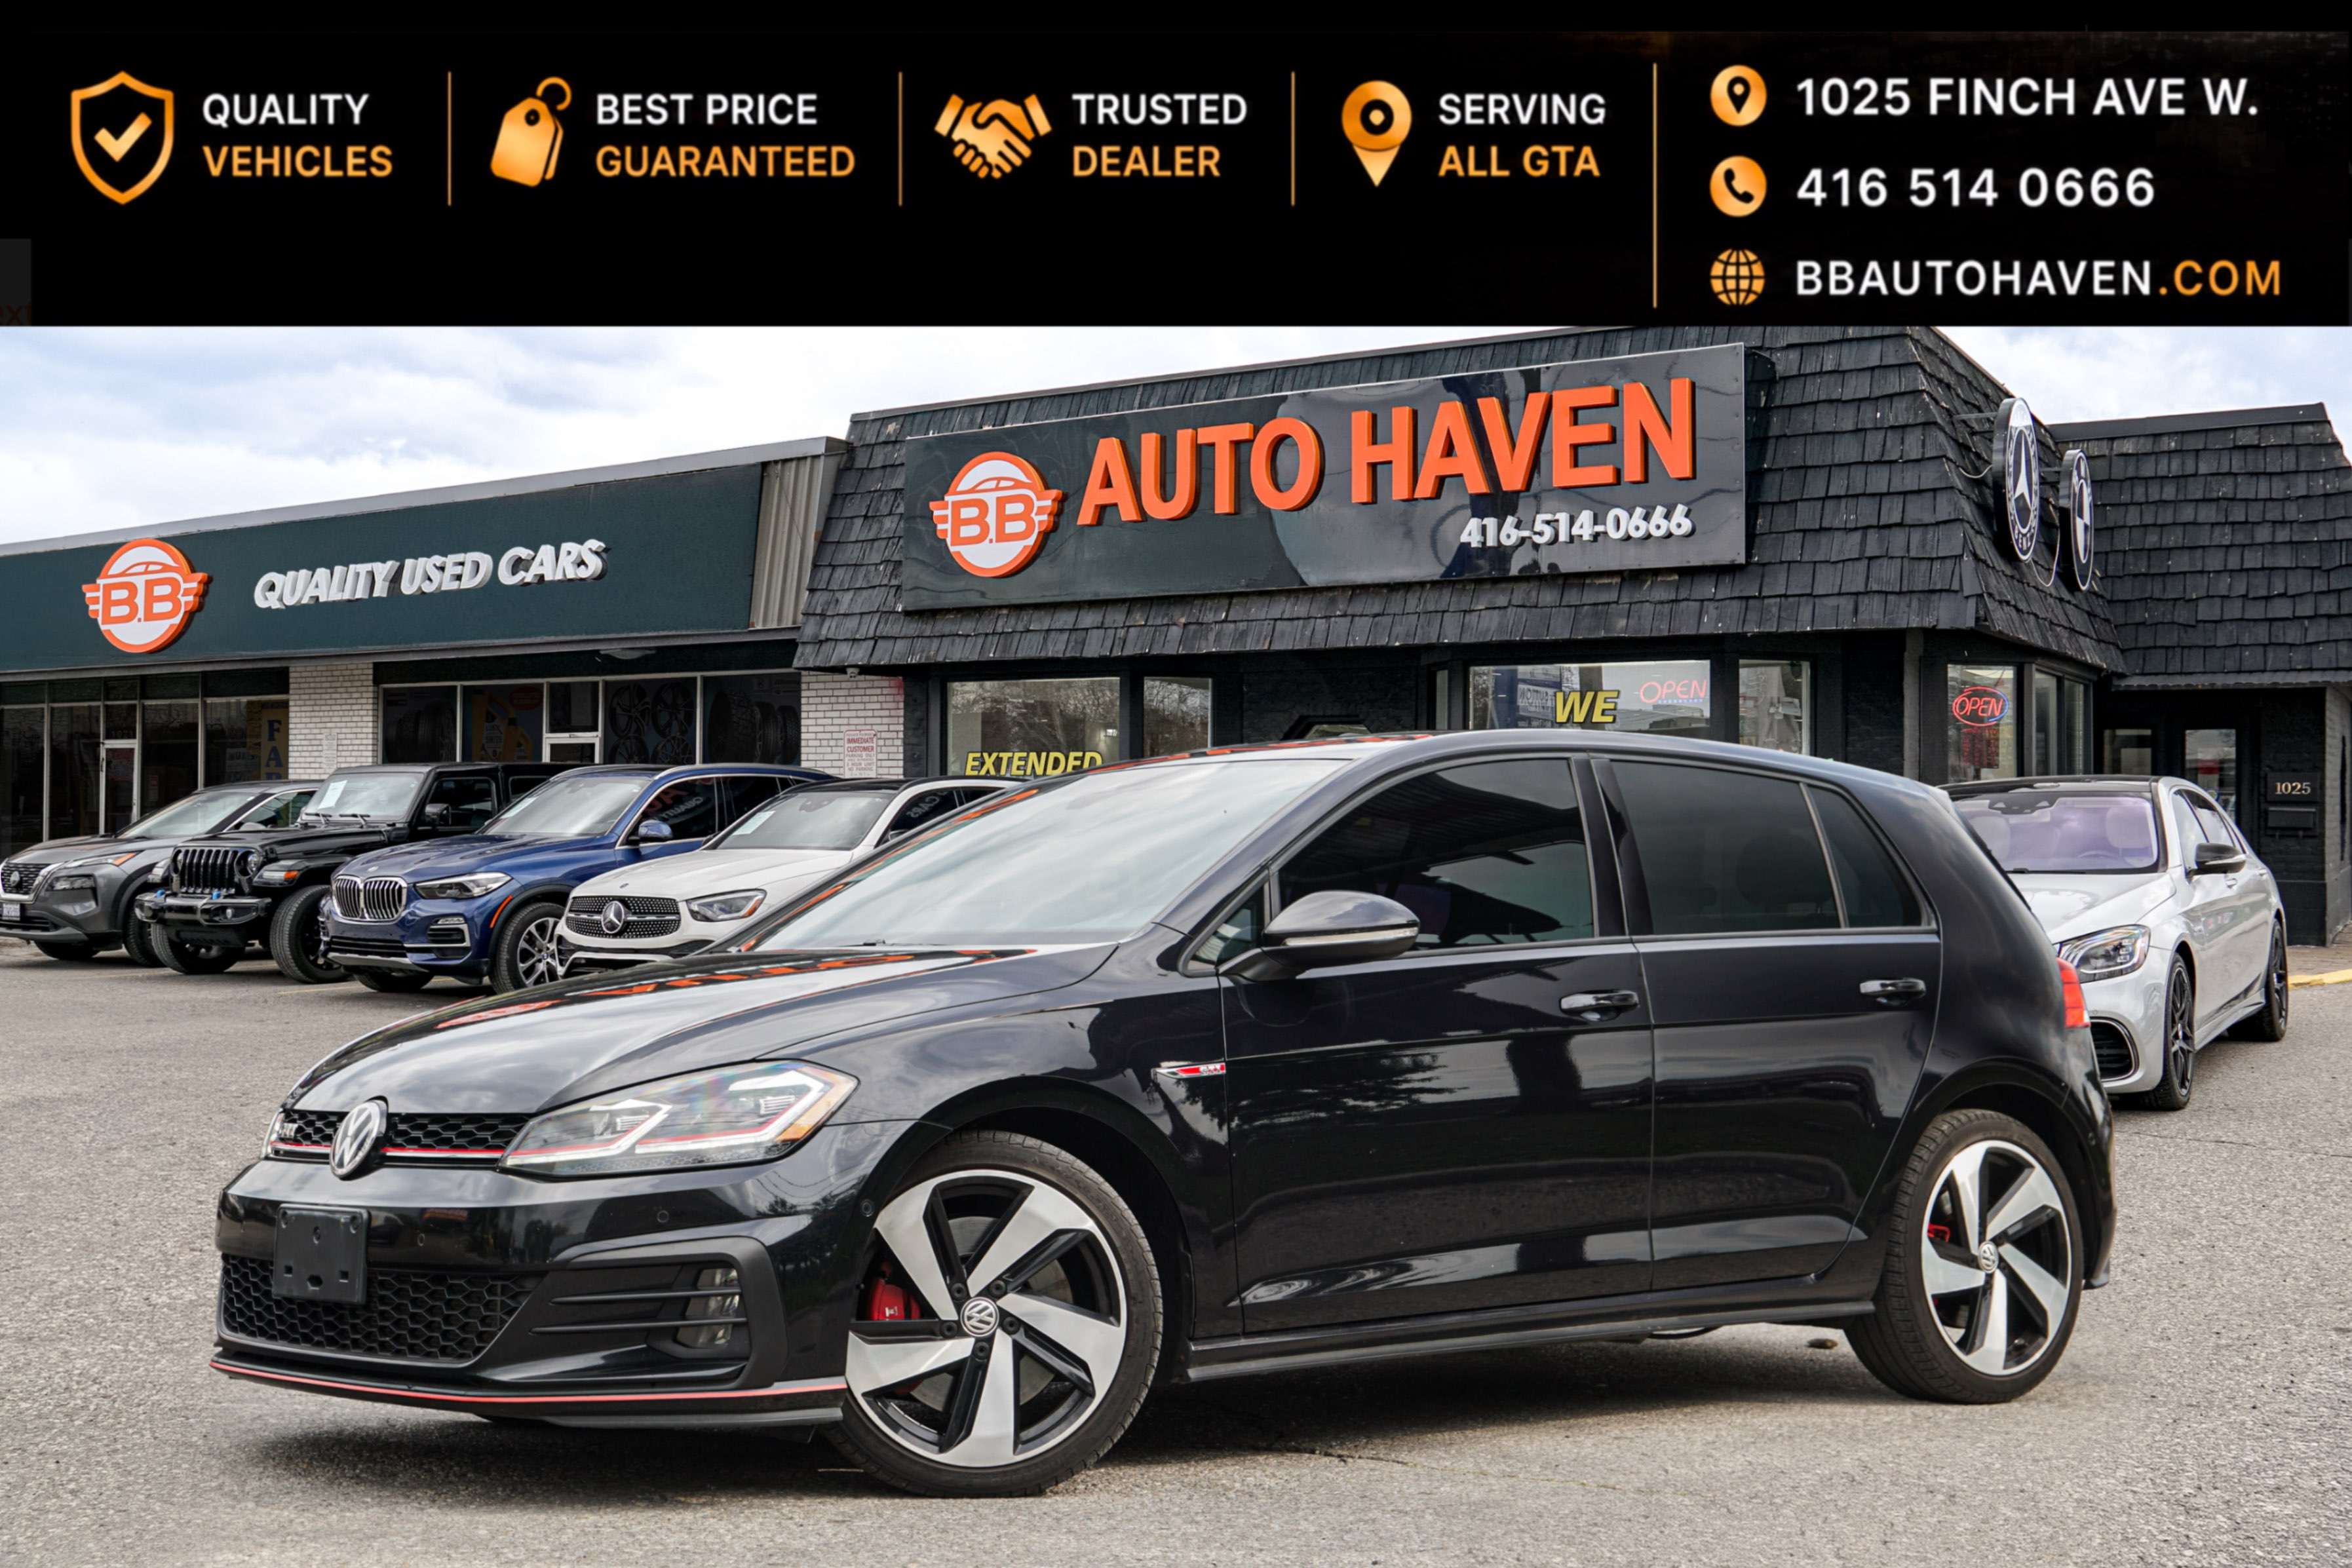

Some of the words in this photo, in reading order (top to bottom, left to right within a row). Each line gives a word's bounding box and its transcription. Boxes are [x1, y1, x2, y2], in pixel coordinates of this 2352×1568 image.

[1077, 417, 1321, 526] AUTO
[1351, 377, 1695, 504] HAVEN
[1459, 503, 1695, 548] 416-514-0666
[254, 560, 399, 609] QUALITY
[400, 552, 493, 596] USED
[498, 539, 606, 585] CARS
[1554, 690, 1621, 724] WE
[1640, 679, 1707, 703] OPEN
[1956, 697, 2003, 717] OPEN
[2275, 782, 2311, 795] 1025
